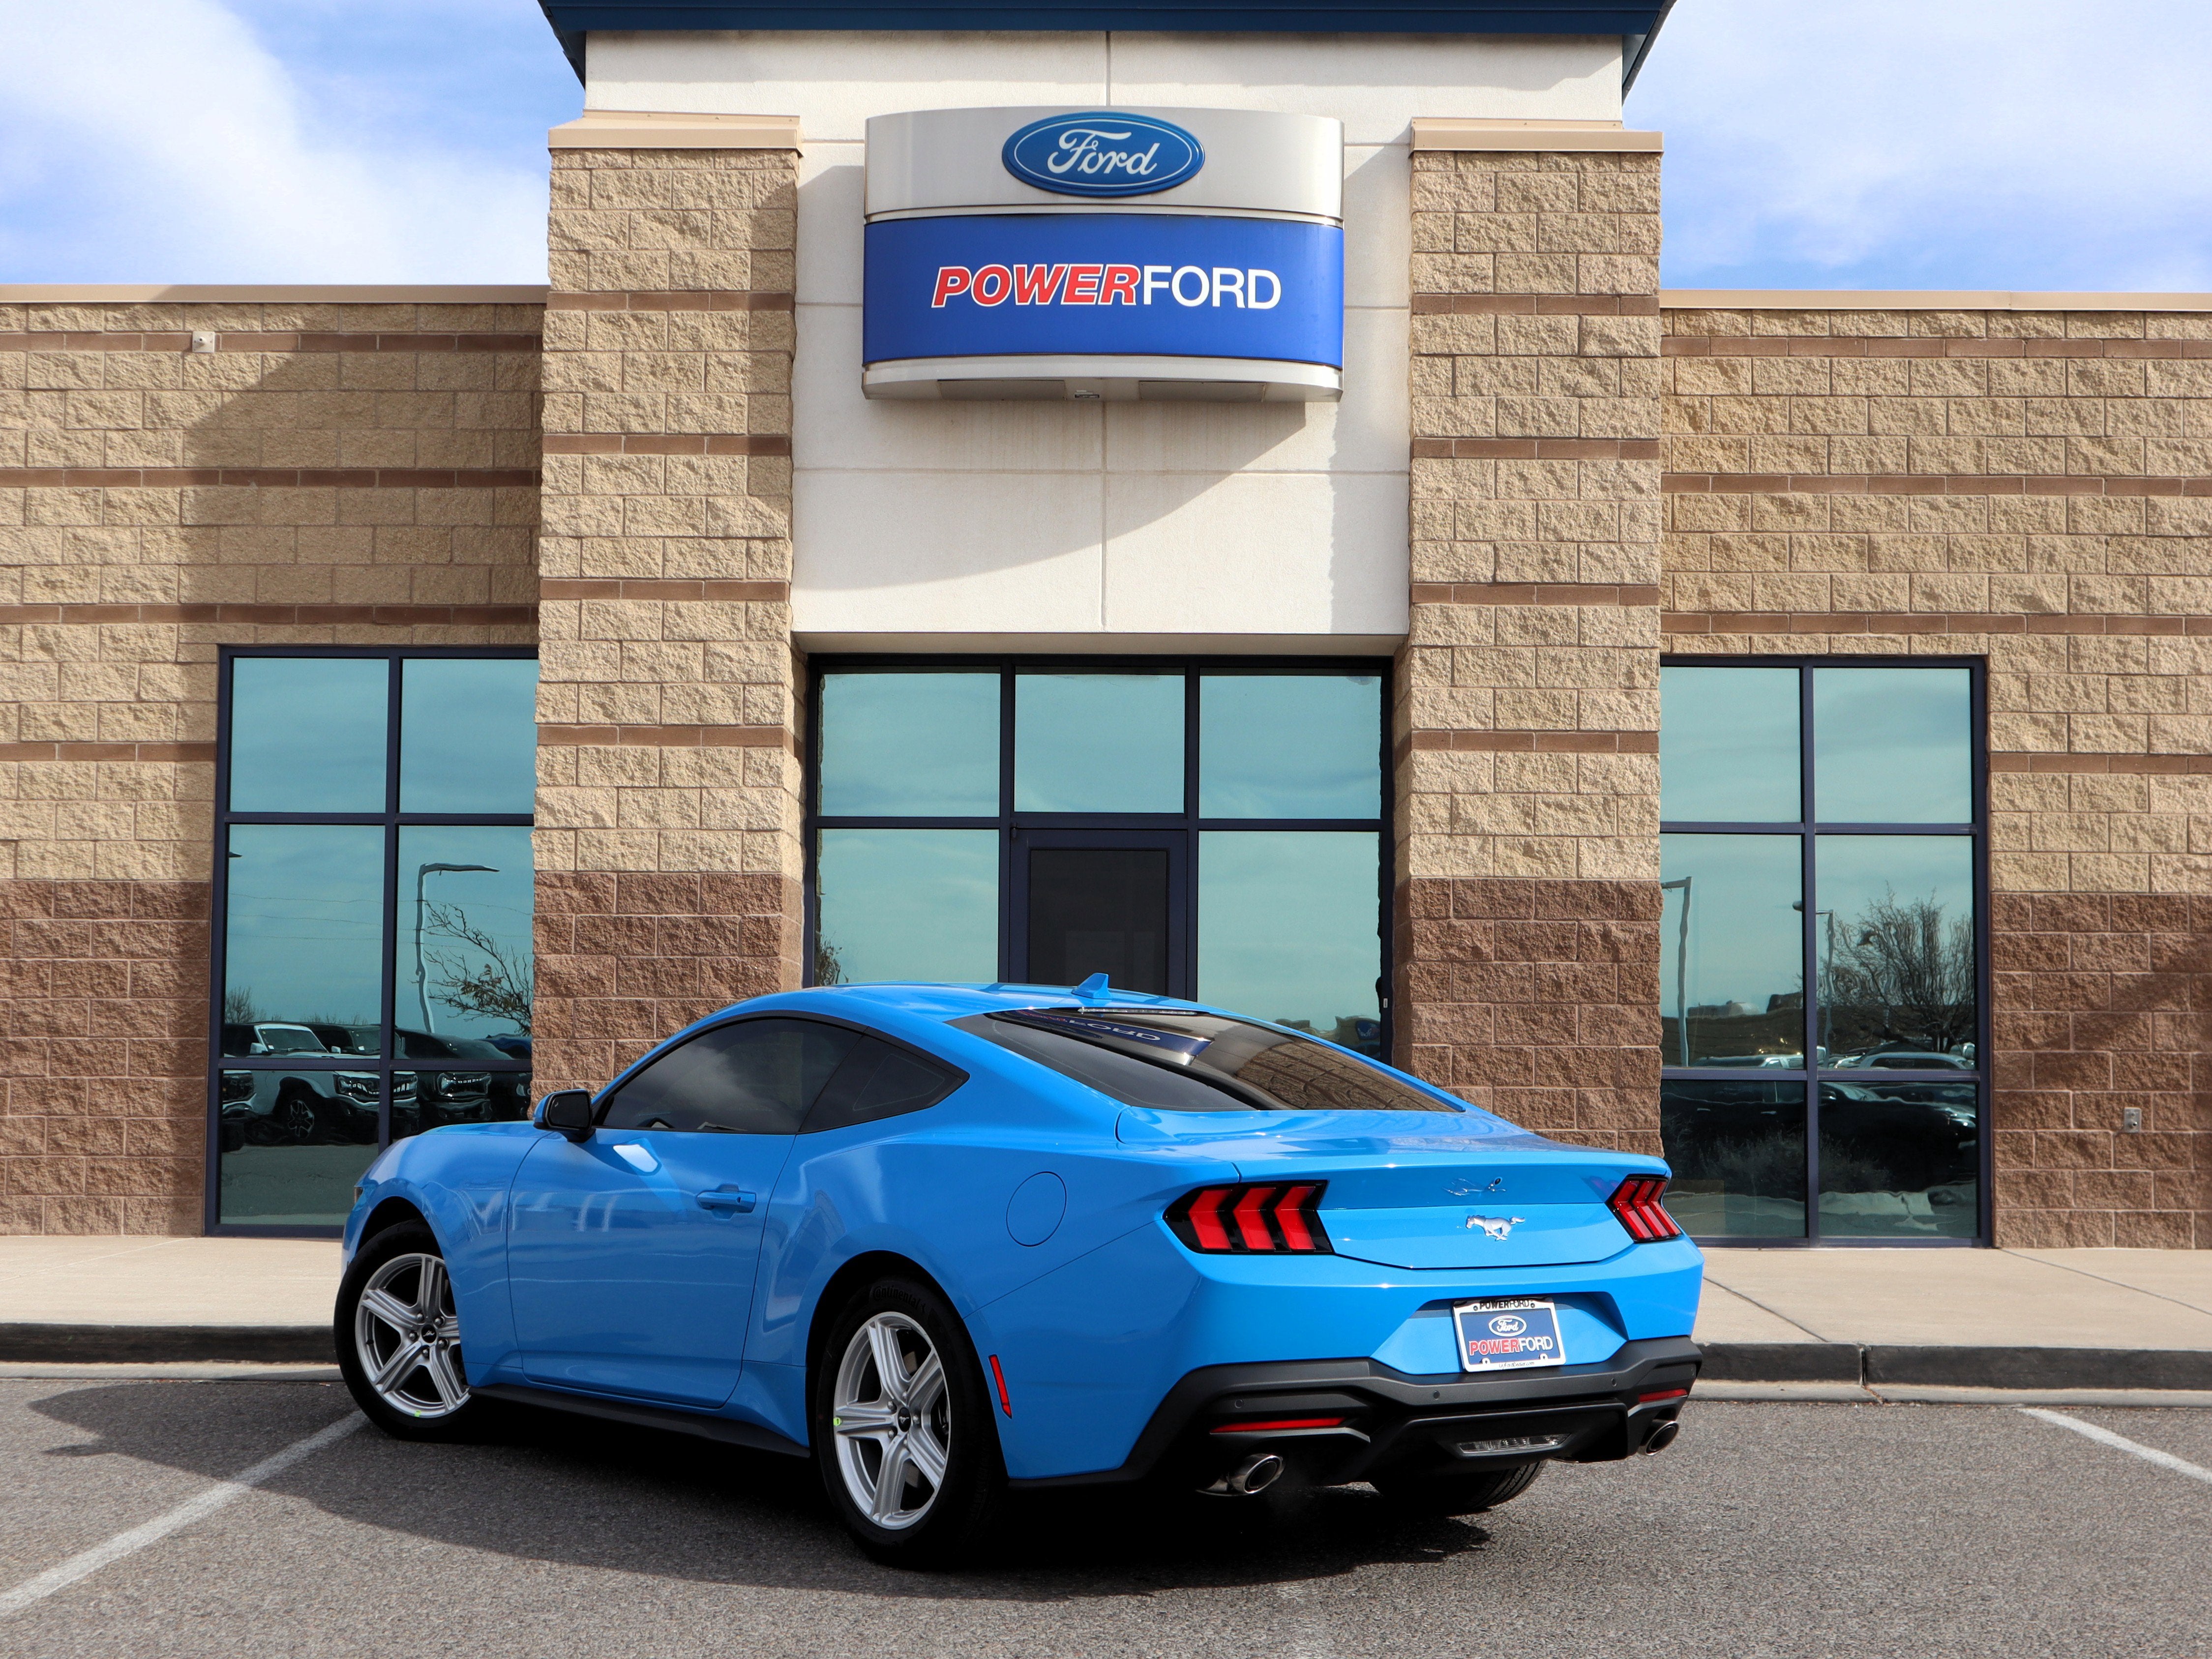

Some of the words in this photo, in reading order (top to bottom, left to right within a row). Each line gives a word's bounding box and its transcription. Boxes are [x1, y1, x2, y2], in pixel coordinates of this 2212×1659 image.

[1046, 129, 1161, 175] Ford
[873, 1285, 921, 1310] Continental
[1496, 1319, 1519, 1332] Ford
